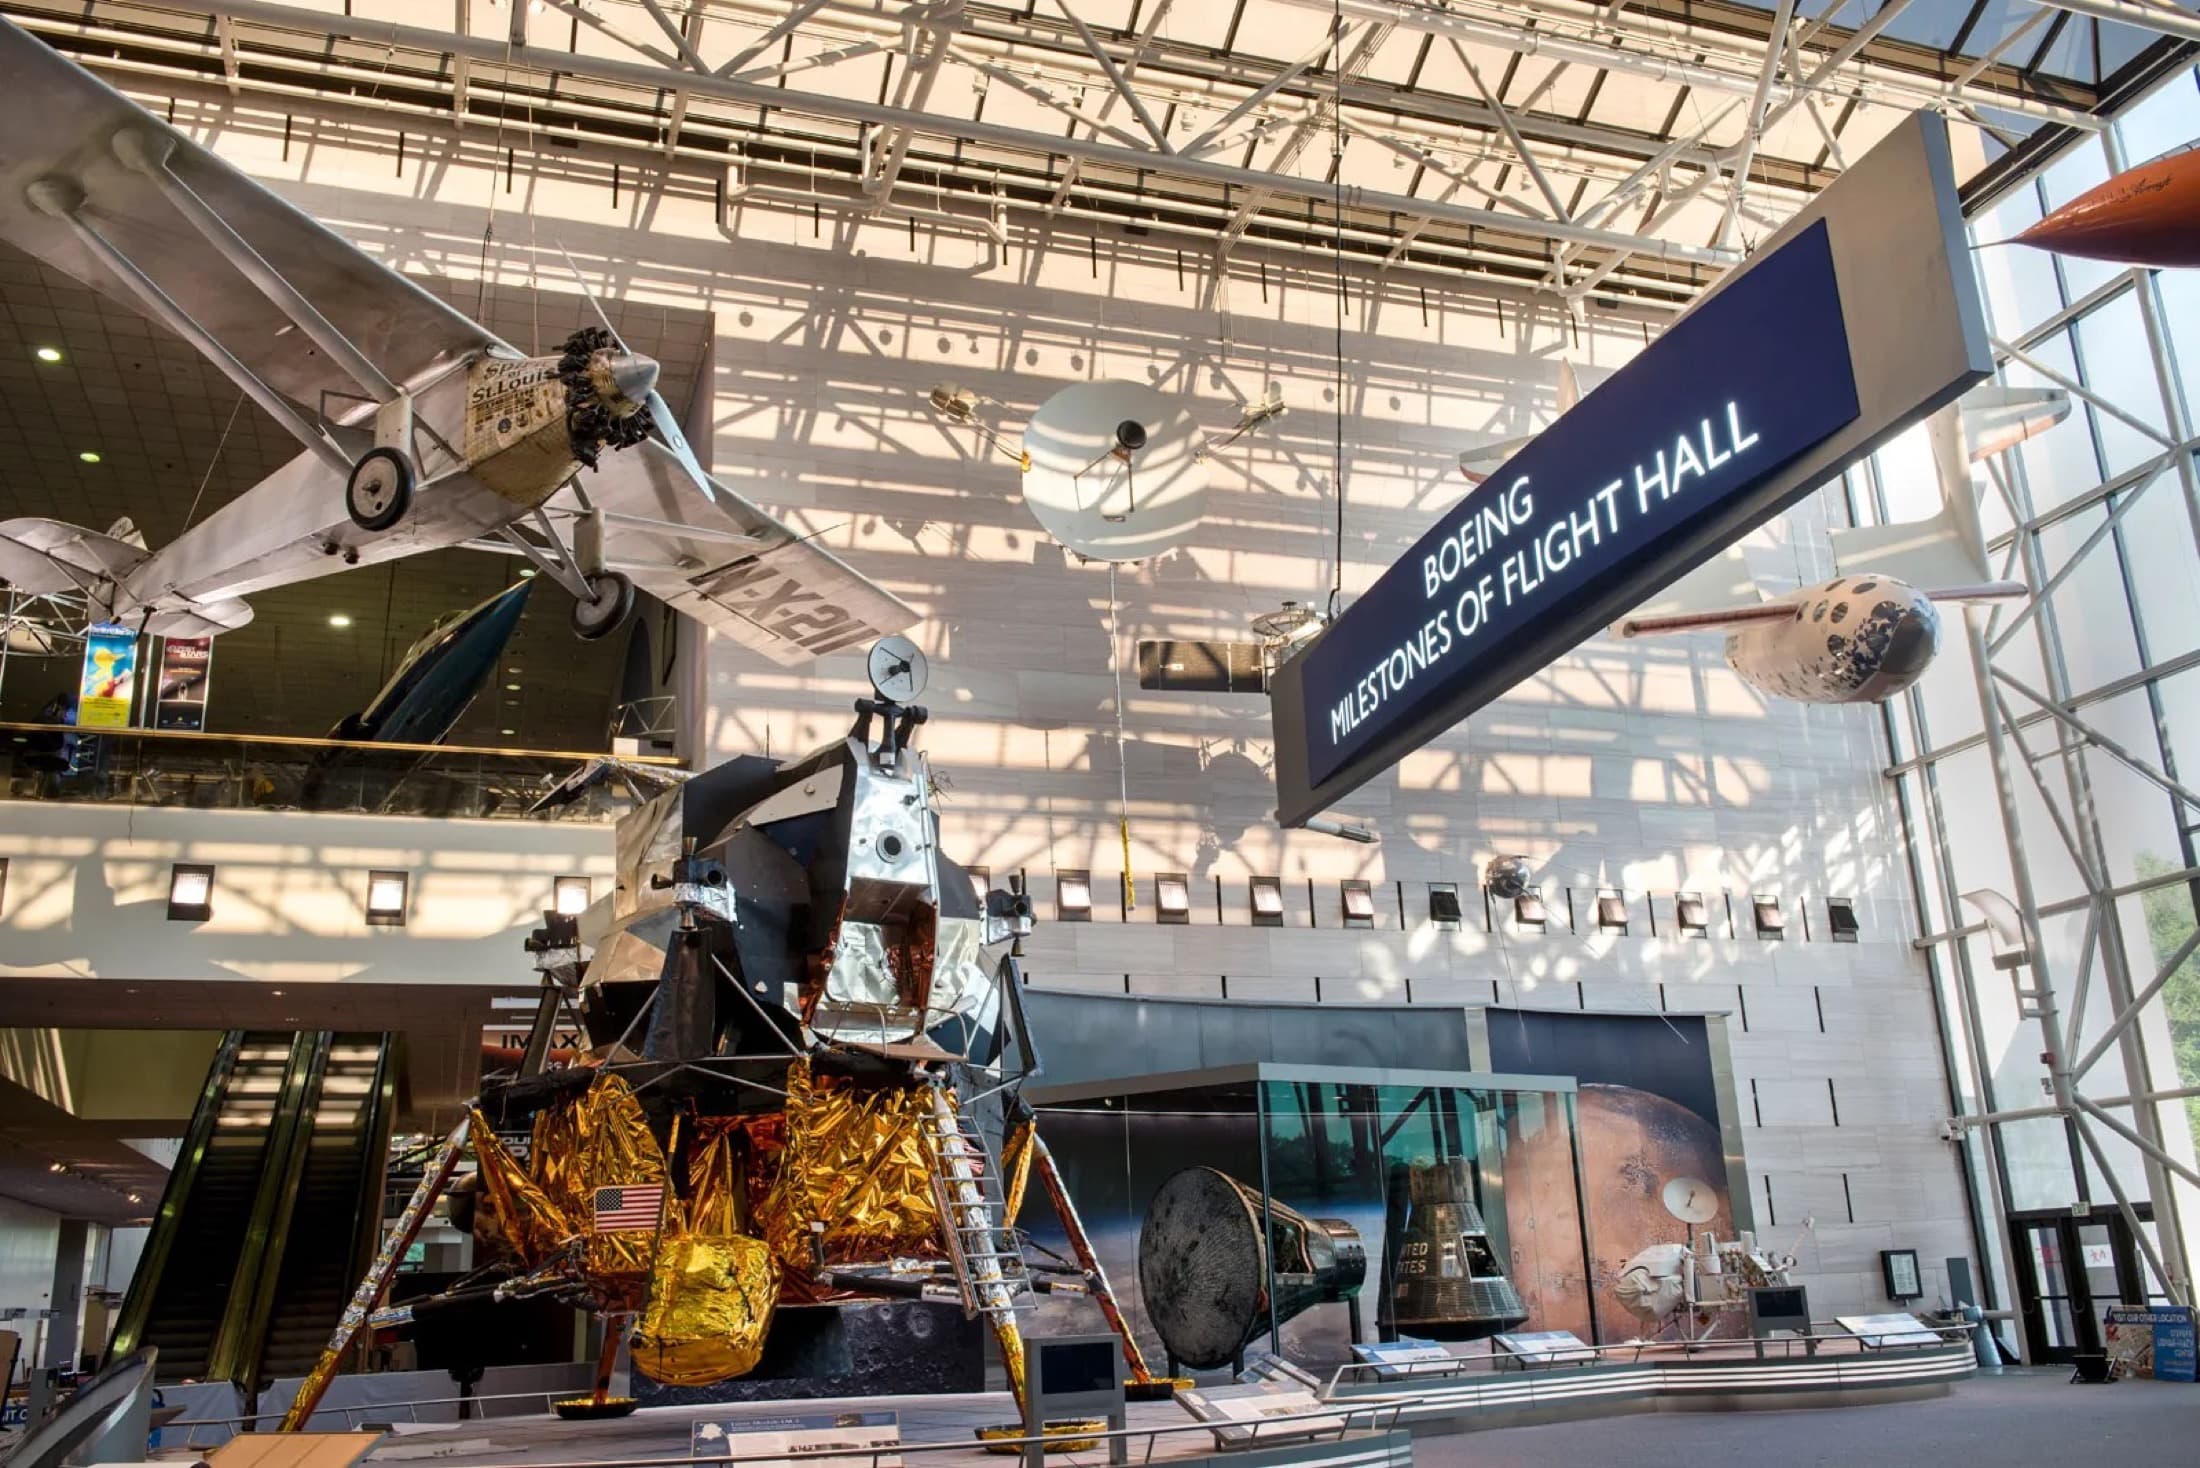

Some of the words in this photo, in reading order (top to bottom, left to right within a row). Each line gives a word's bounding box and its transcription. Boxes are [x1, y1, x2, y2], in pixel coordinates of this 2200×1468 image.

[1331, 608, 1452, 745] MILESTONES
[1456, 575, 1496, 637] OF
[1502, 479, 1625, 606] FLIGHT
[1634, 400, 1760, 514] HALL
[1423, 475, 1534, 599] BOEING
[501, 1034, 579, 1050] IMX
